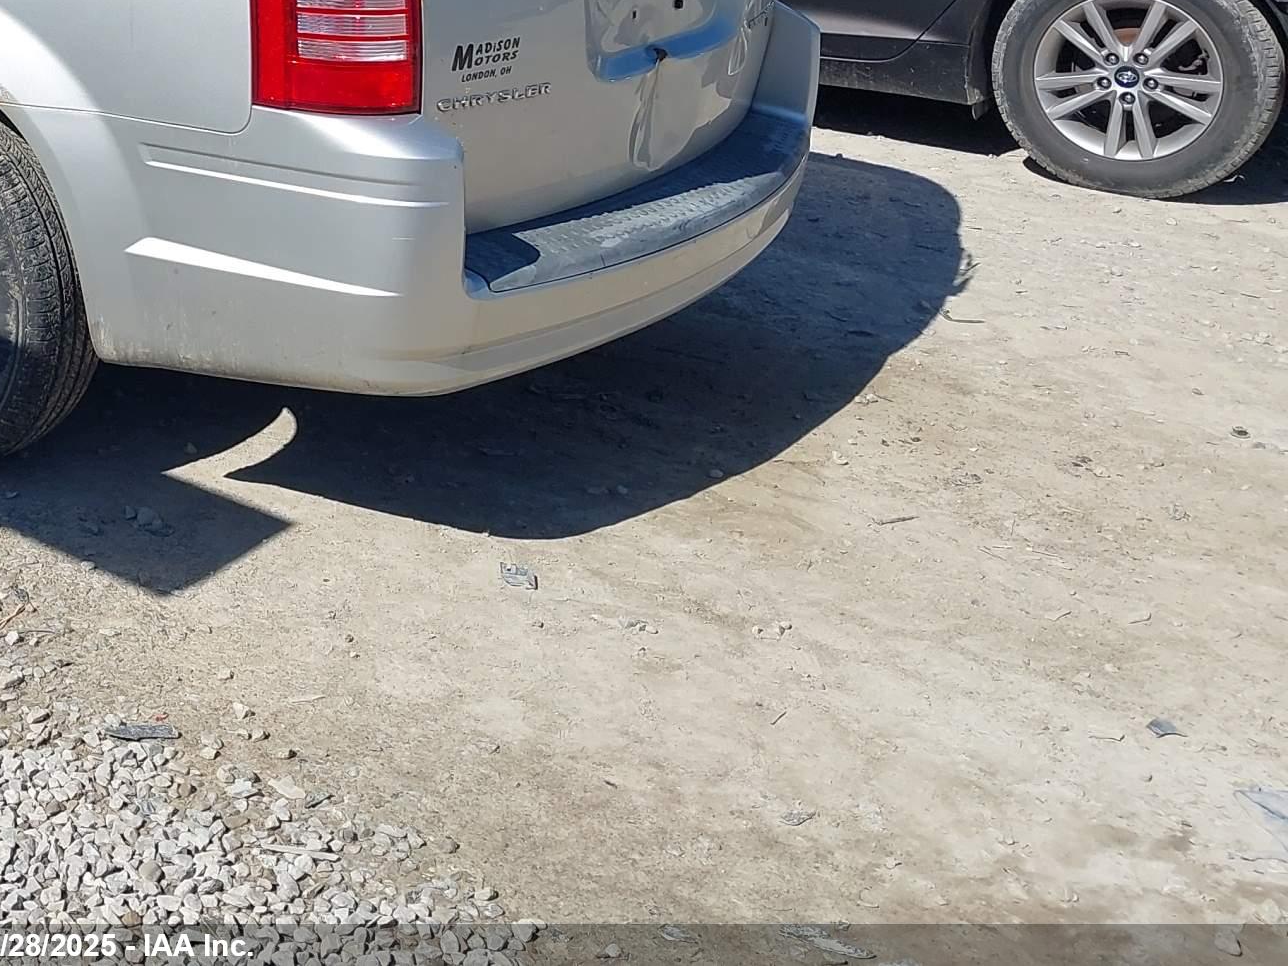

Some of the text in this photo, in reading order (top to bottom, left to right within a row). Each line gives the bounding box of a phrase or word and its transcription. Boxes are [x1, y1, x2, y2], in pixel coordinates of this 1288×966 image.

[461, 66, 513, 83] LONDON, OH
[436, 82, 552, 112] CHRYSLER
